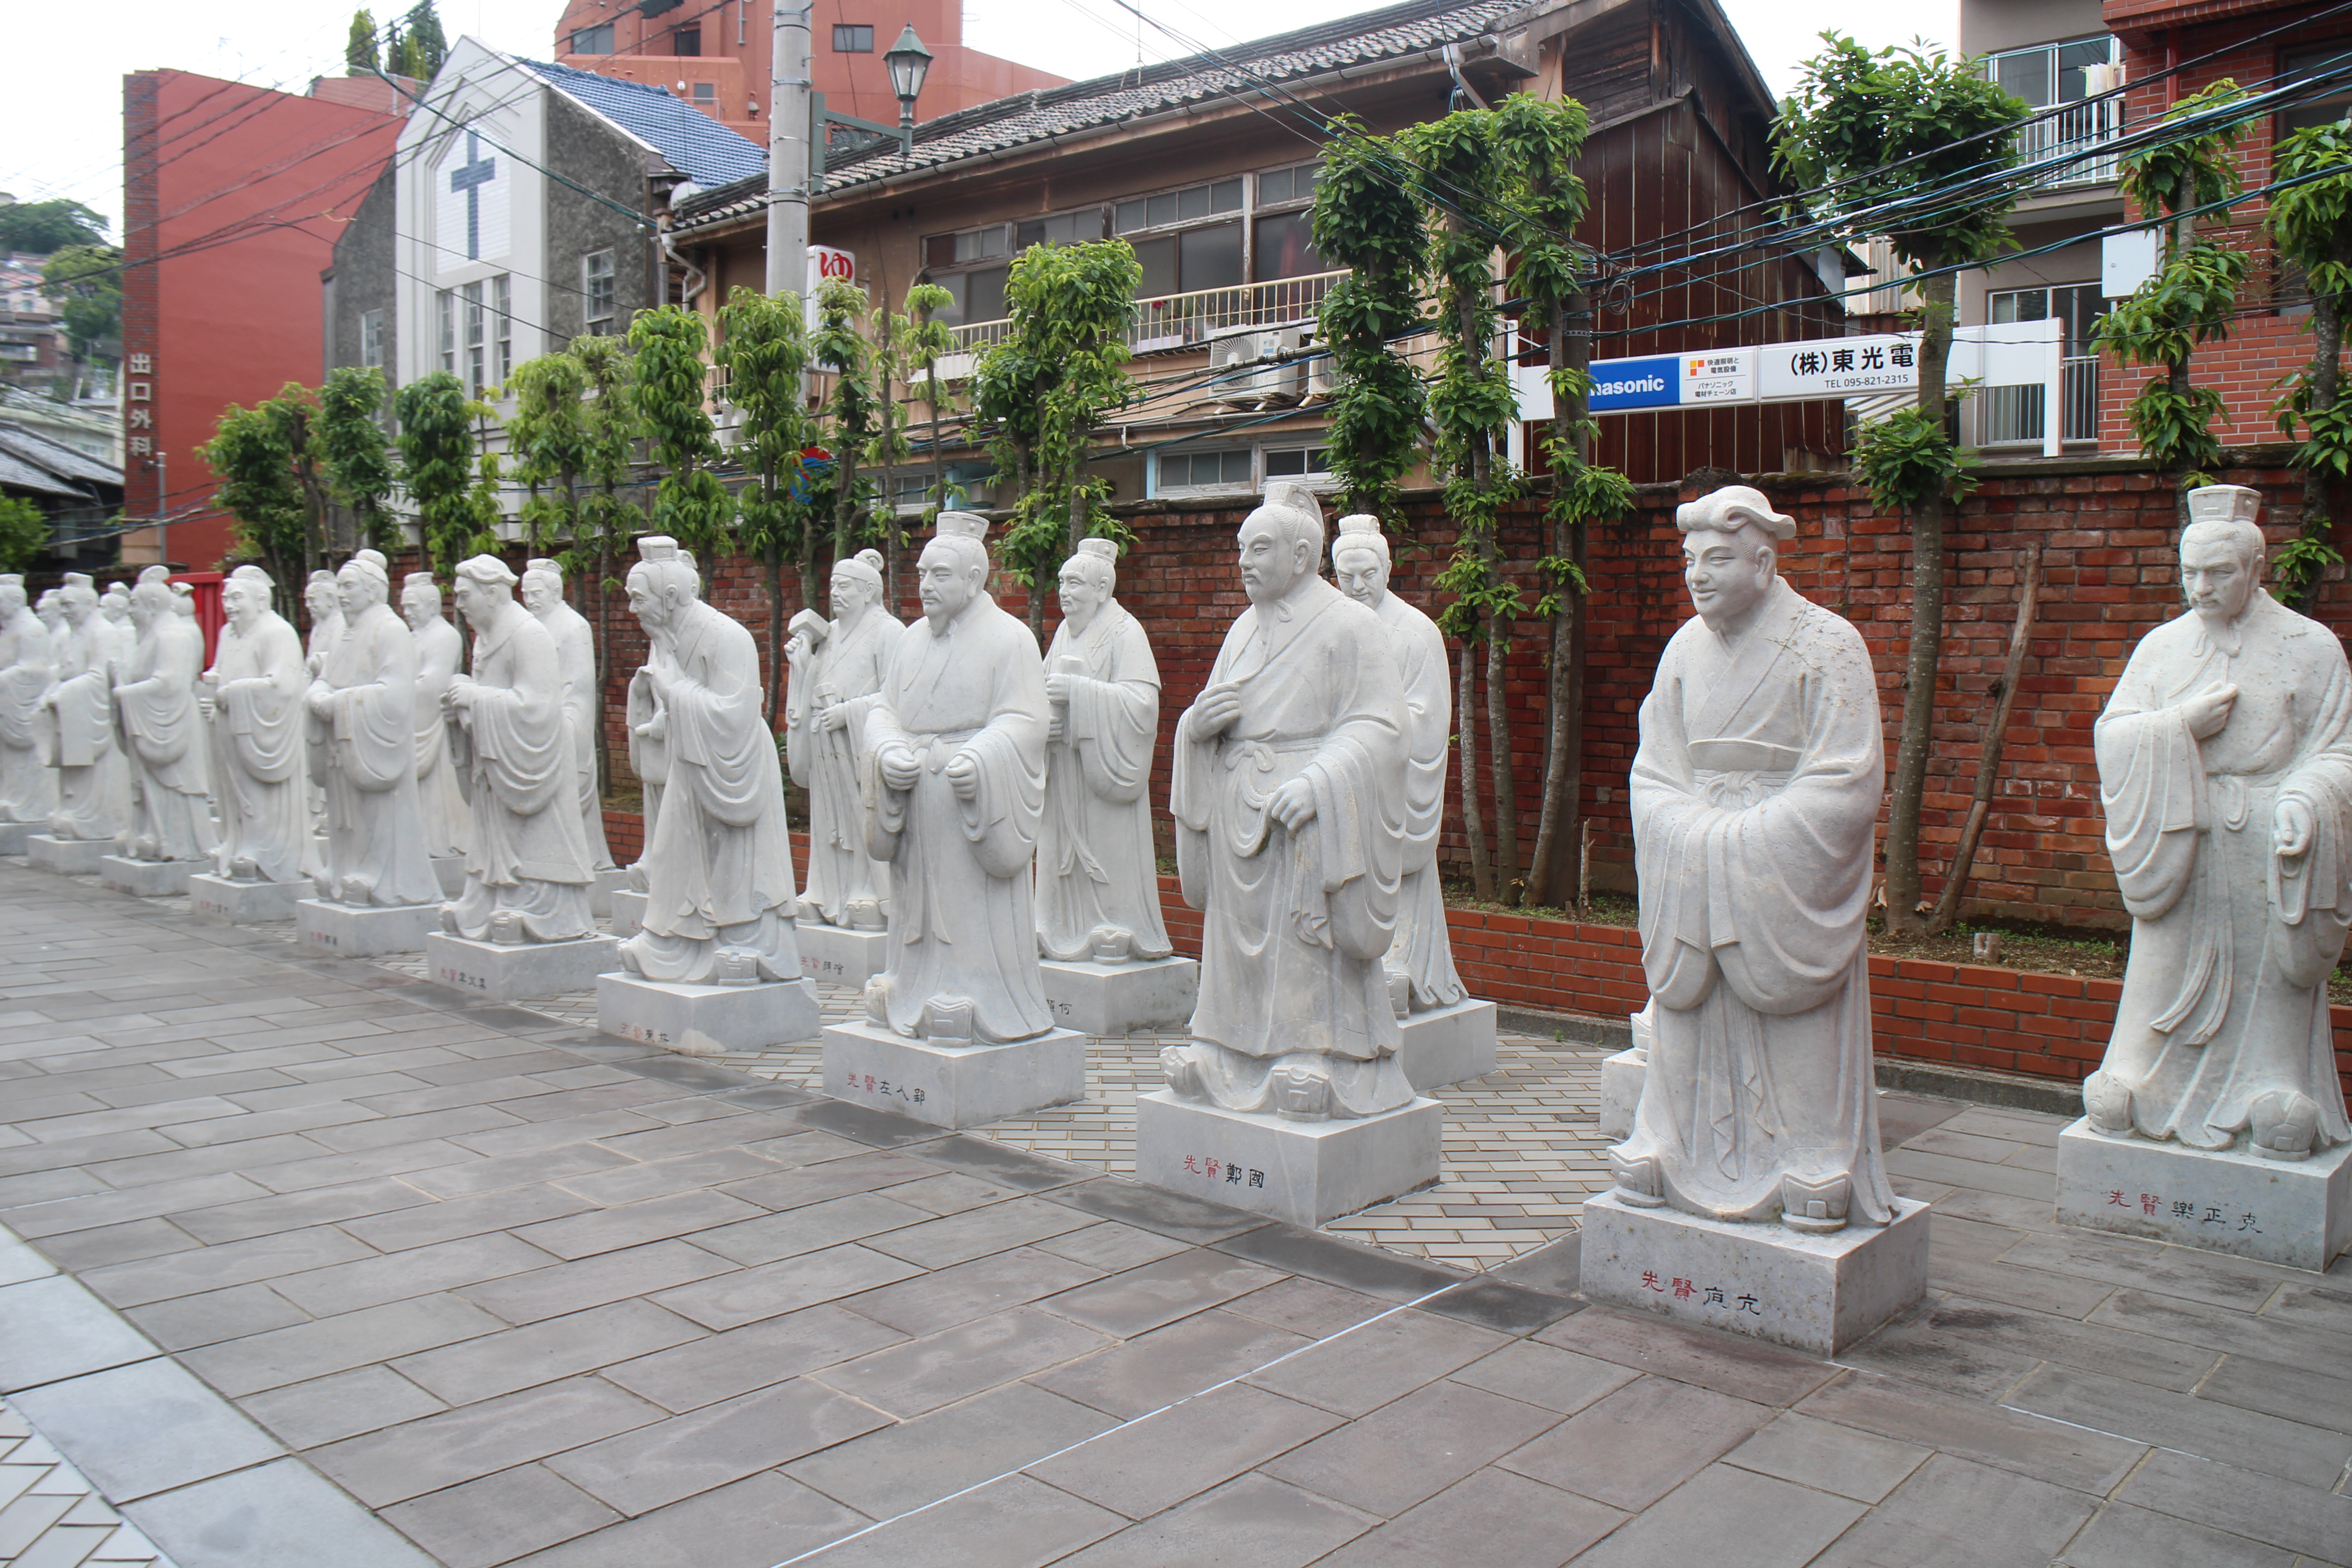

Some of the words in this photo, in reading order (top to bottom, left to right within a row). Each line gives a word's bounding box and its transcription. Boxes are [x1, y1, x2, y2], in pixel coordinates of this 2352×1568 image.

[820, 252, 853, 282] ゆ
[1707, 357, 1740, 366] 快適照明と
[1710, 365, 1736, 374] 電気設備
[1589, 374, 1665, 397] nasonic
[1698, 381, 1733, 389] パナソニック
[1824, 379, 1842, 388] TEL
[1844, 374, 1909, 387] 095-821-2315
[1695, 388, 1737, 397] 電材チェーン店
[128, 352, 152, 456] 出口外科
